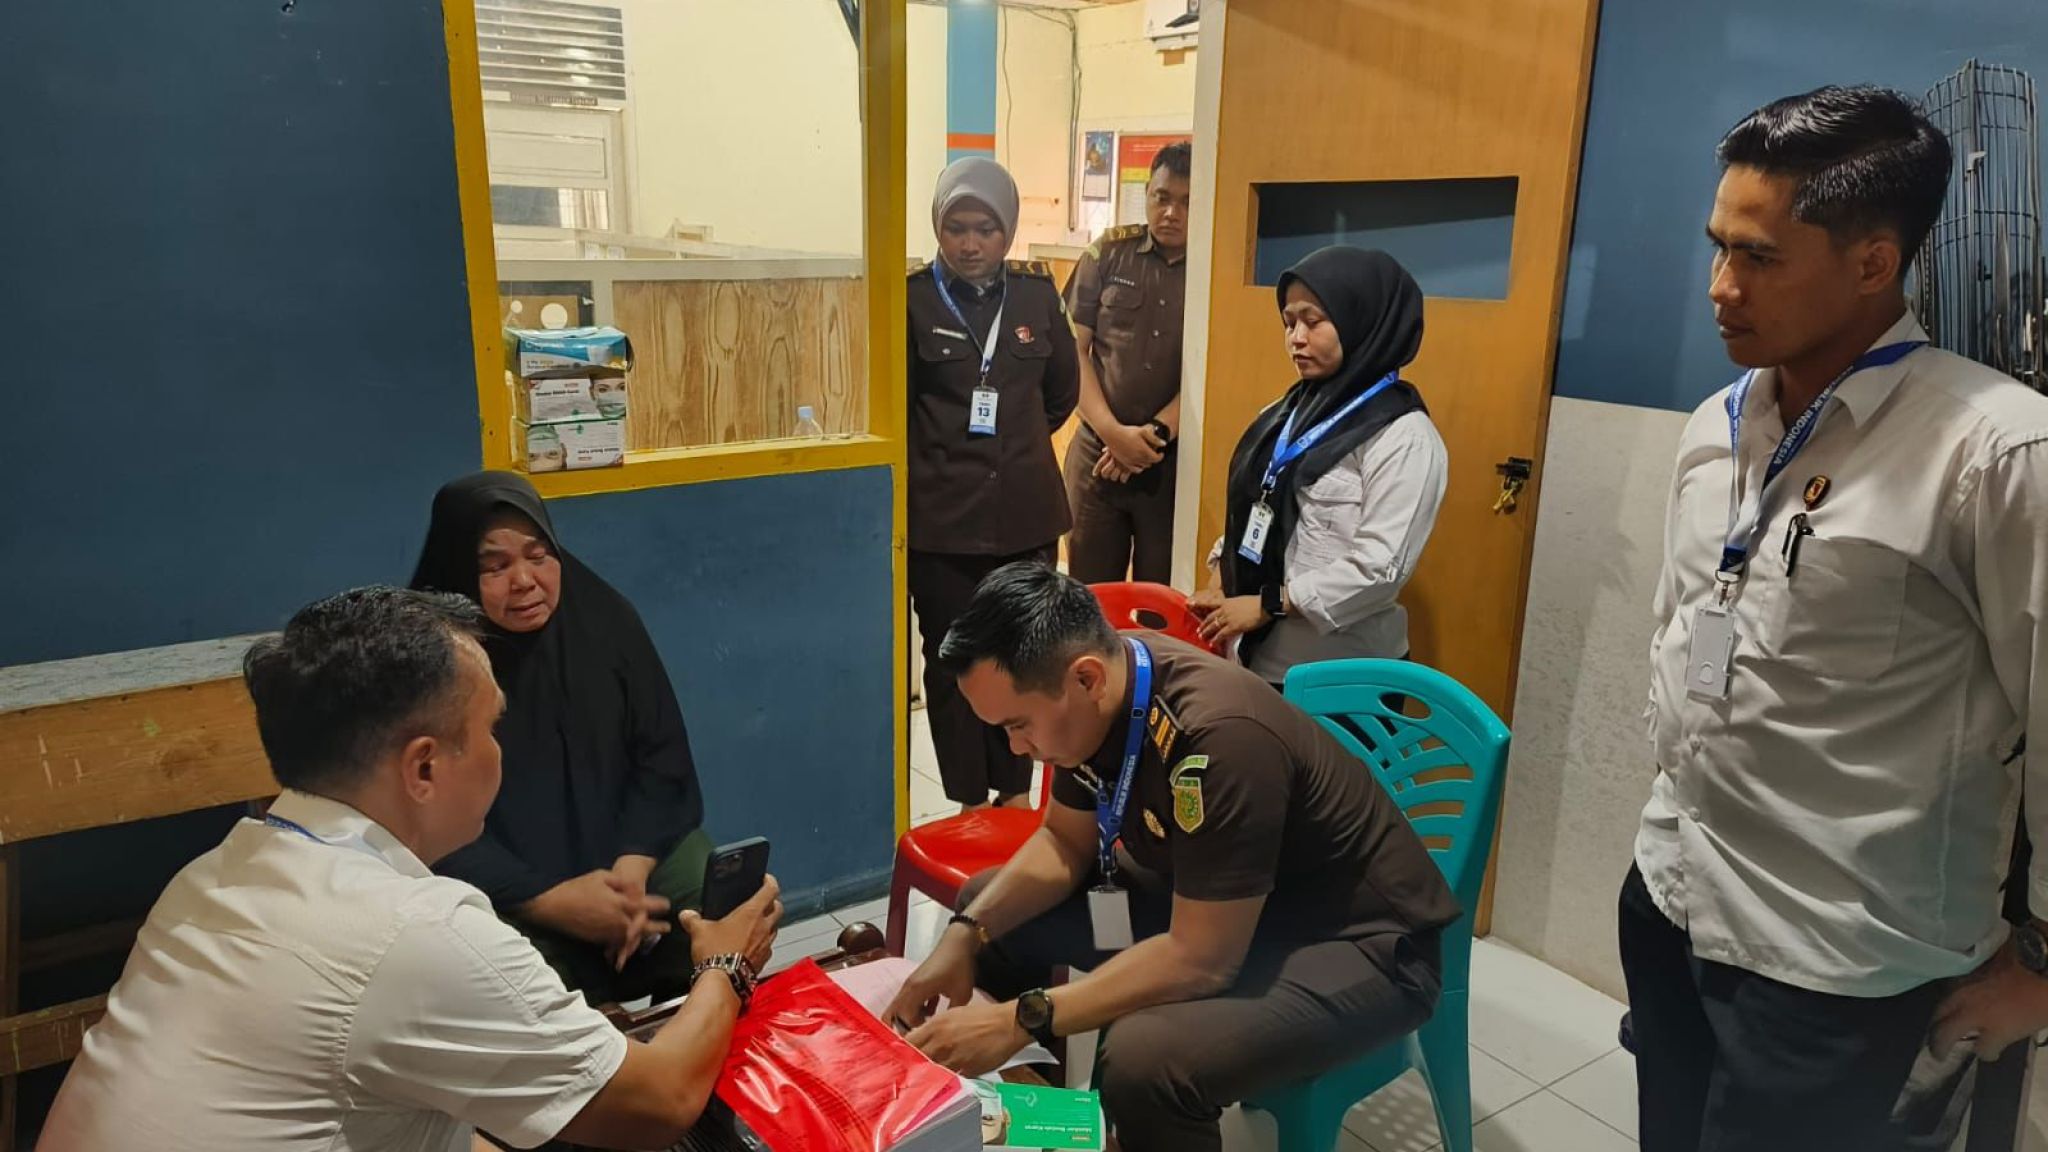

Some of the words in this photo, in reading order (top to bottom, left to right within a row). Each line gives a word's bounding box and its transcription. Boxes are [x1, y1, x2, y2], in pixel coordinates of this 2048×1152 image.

[977, 406, 990, 417] 13
[1773, 409, 1814, 465] INDONESIA
[1252, 528, 1259, 540] 6
